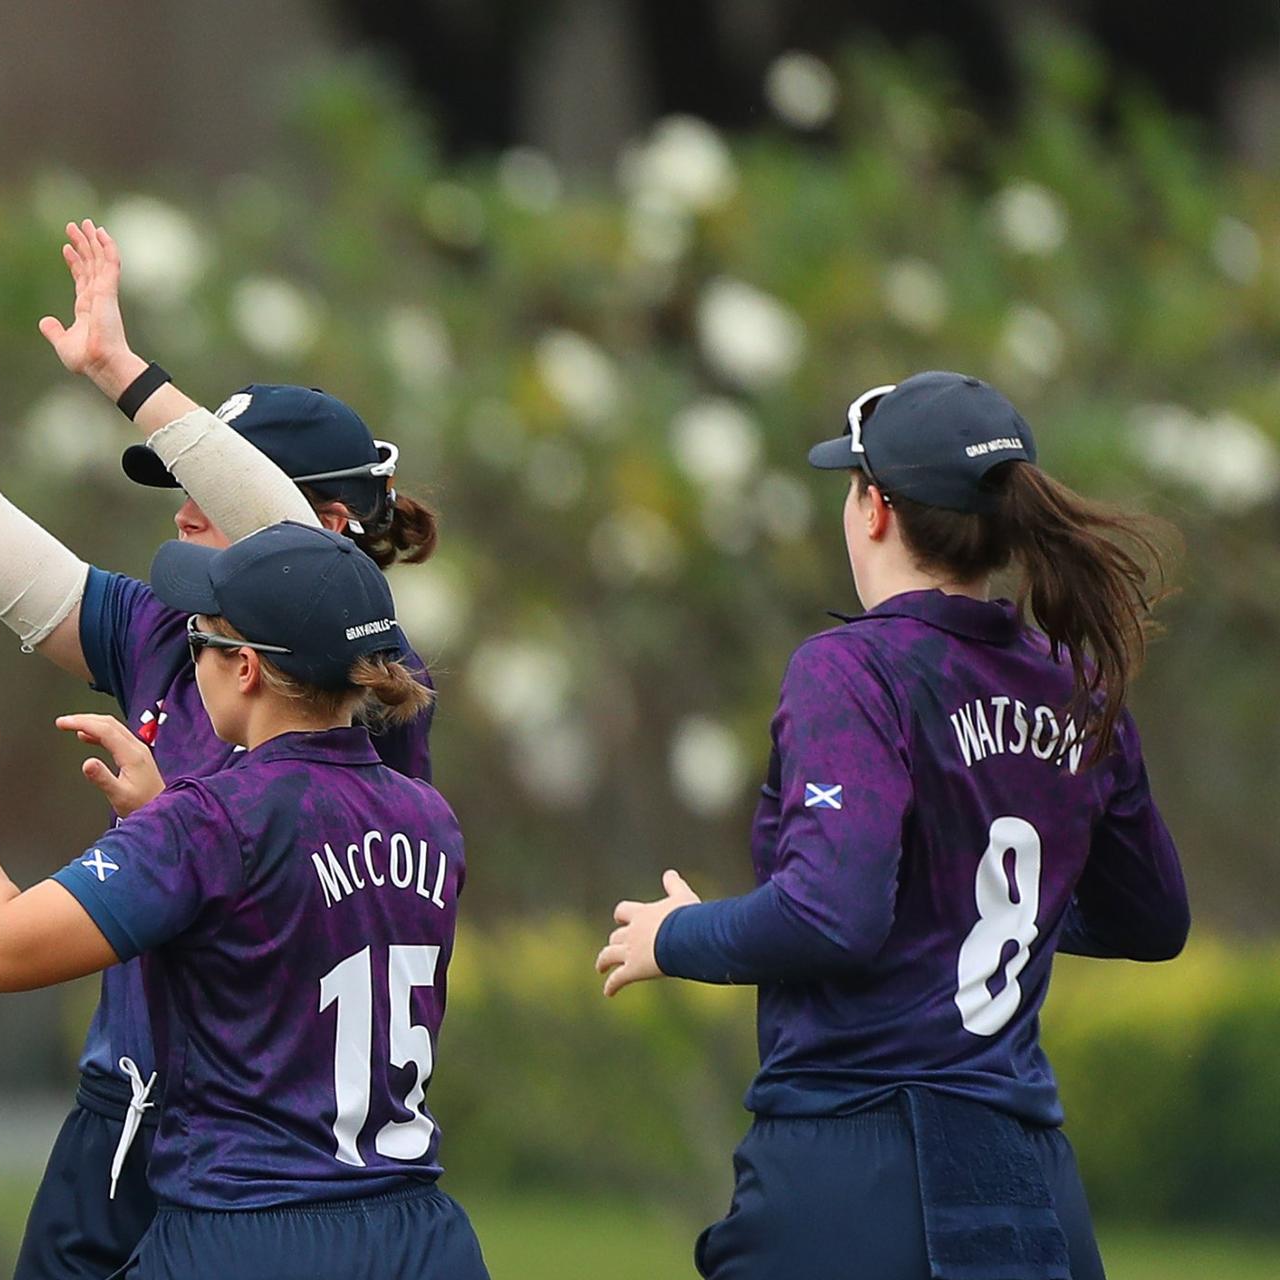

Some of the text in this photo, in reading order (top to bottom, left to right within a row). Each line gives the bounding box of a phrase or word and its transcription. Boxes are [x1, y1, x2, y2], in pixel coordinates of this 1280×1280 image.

[949, 696, 1086, 776] WATSON
[954, 816, 1042, 1037] 8
[319, 944, 441, 1168] 15
